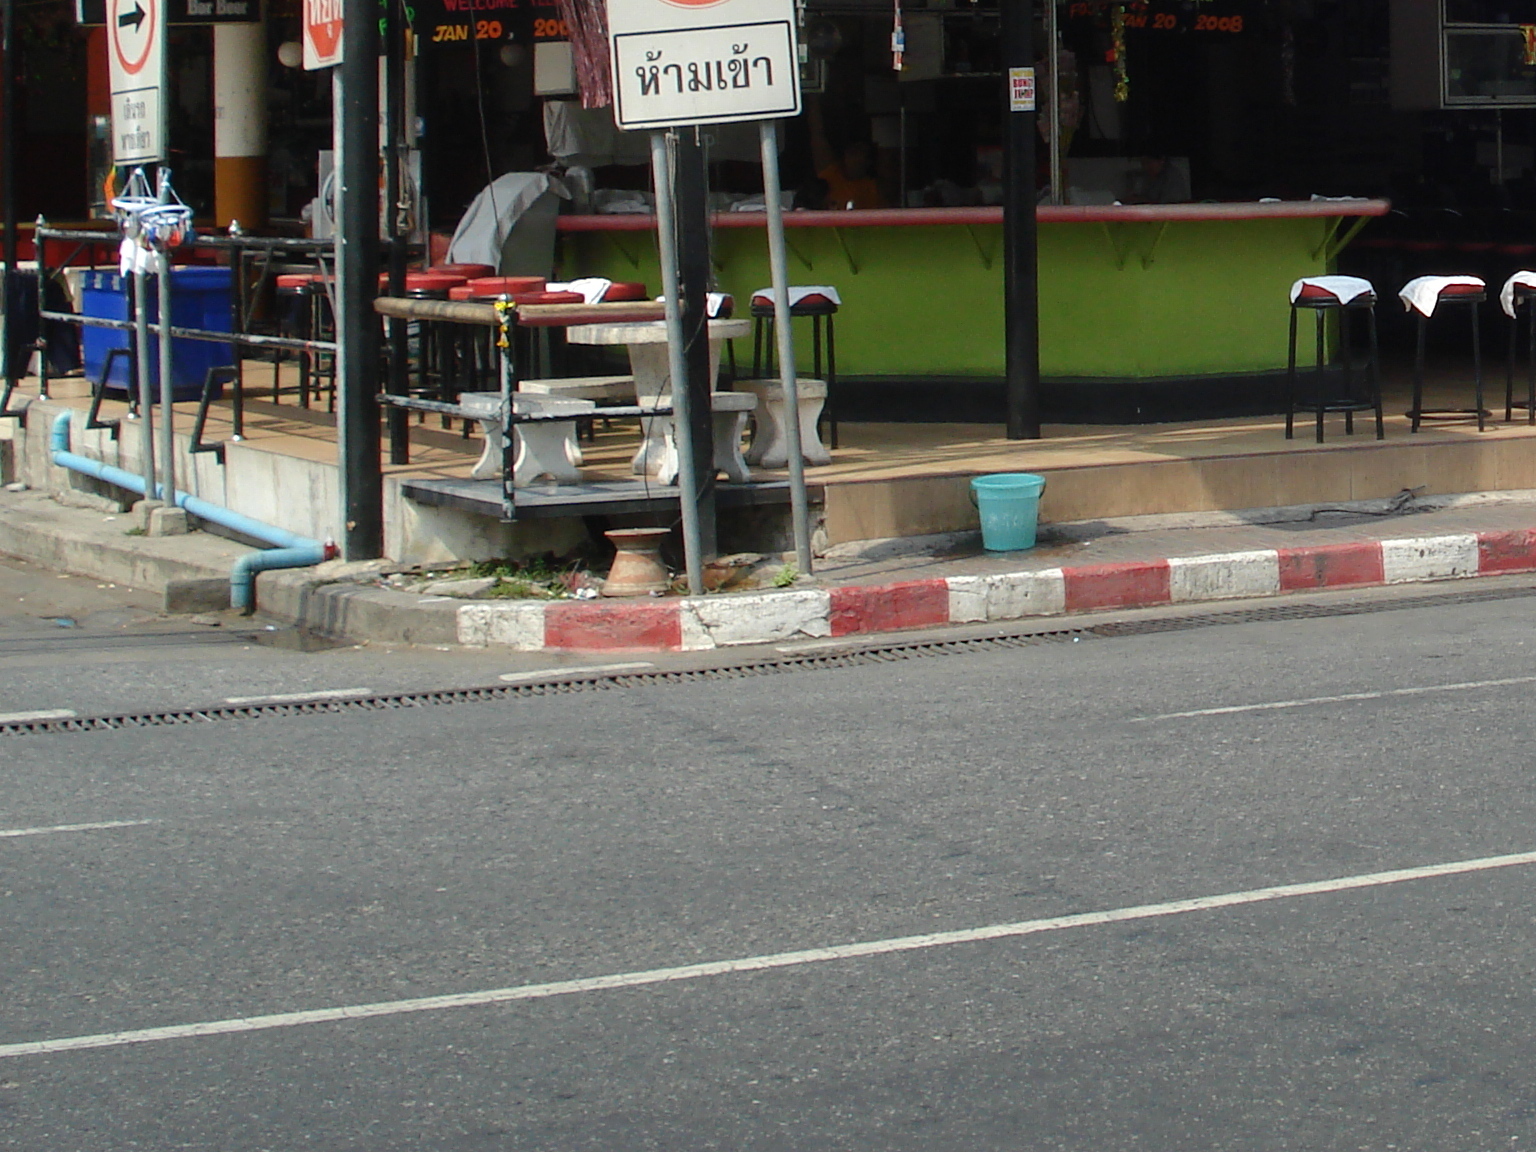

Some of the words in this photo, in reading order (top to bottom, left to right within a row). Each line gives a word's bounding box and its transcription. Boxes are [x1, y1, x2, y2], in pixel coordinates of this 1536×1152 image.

[1194, 14, 1243, 33] 2008
[432, 25, 469, 42] JAN
[635, 43, 774, 96] ห้ามเข้า
